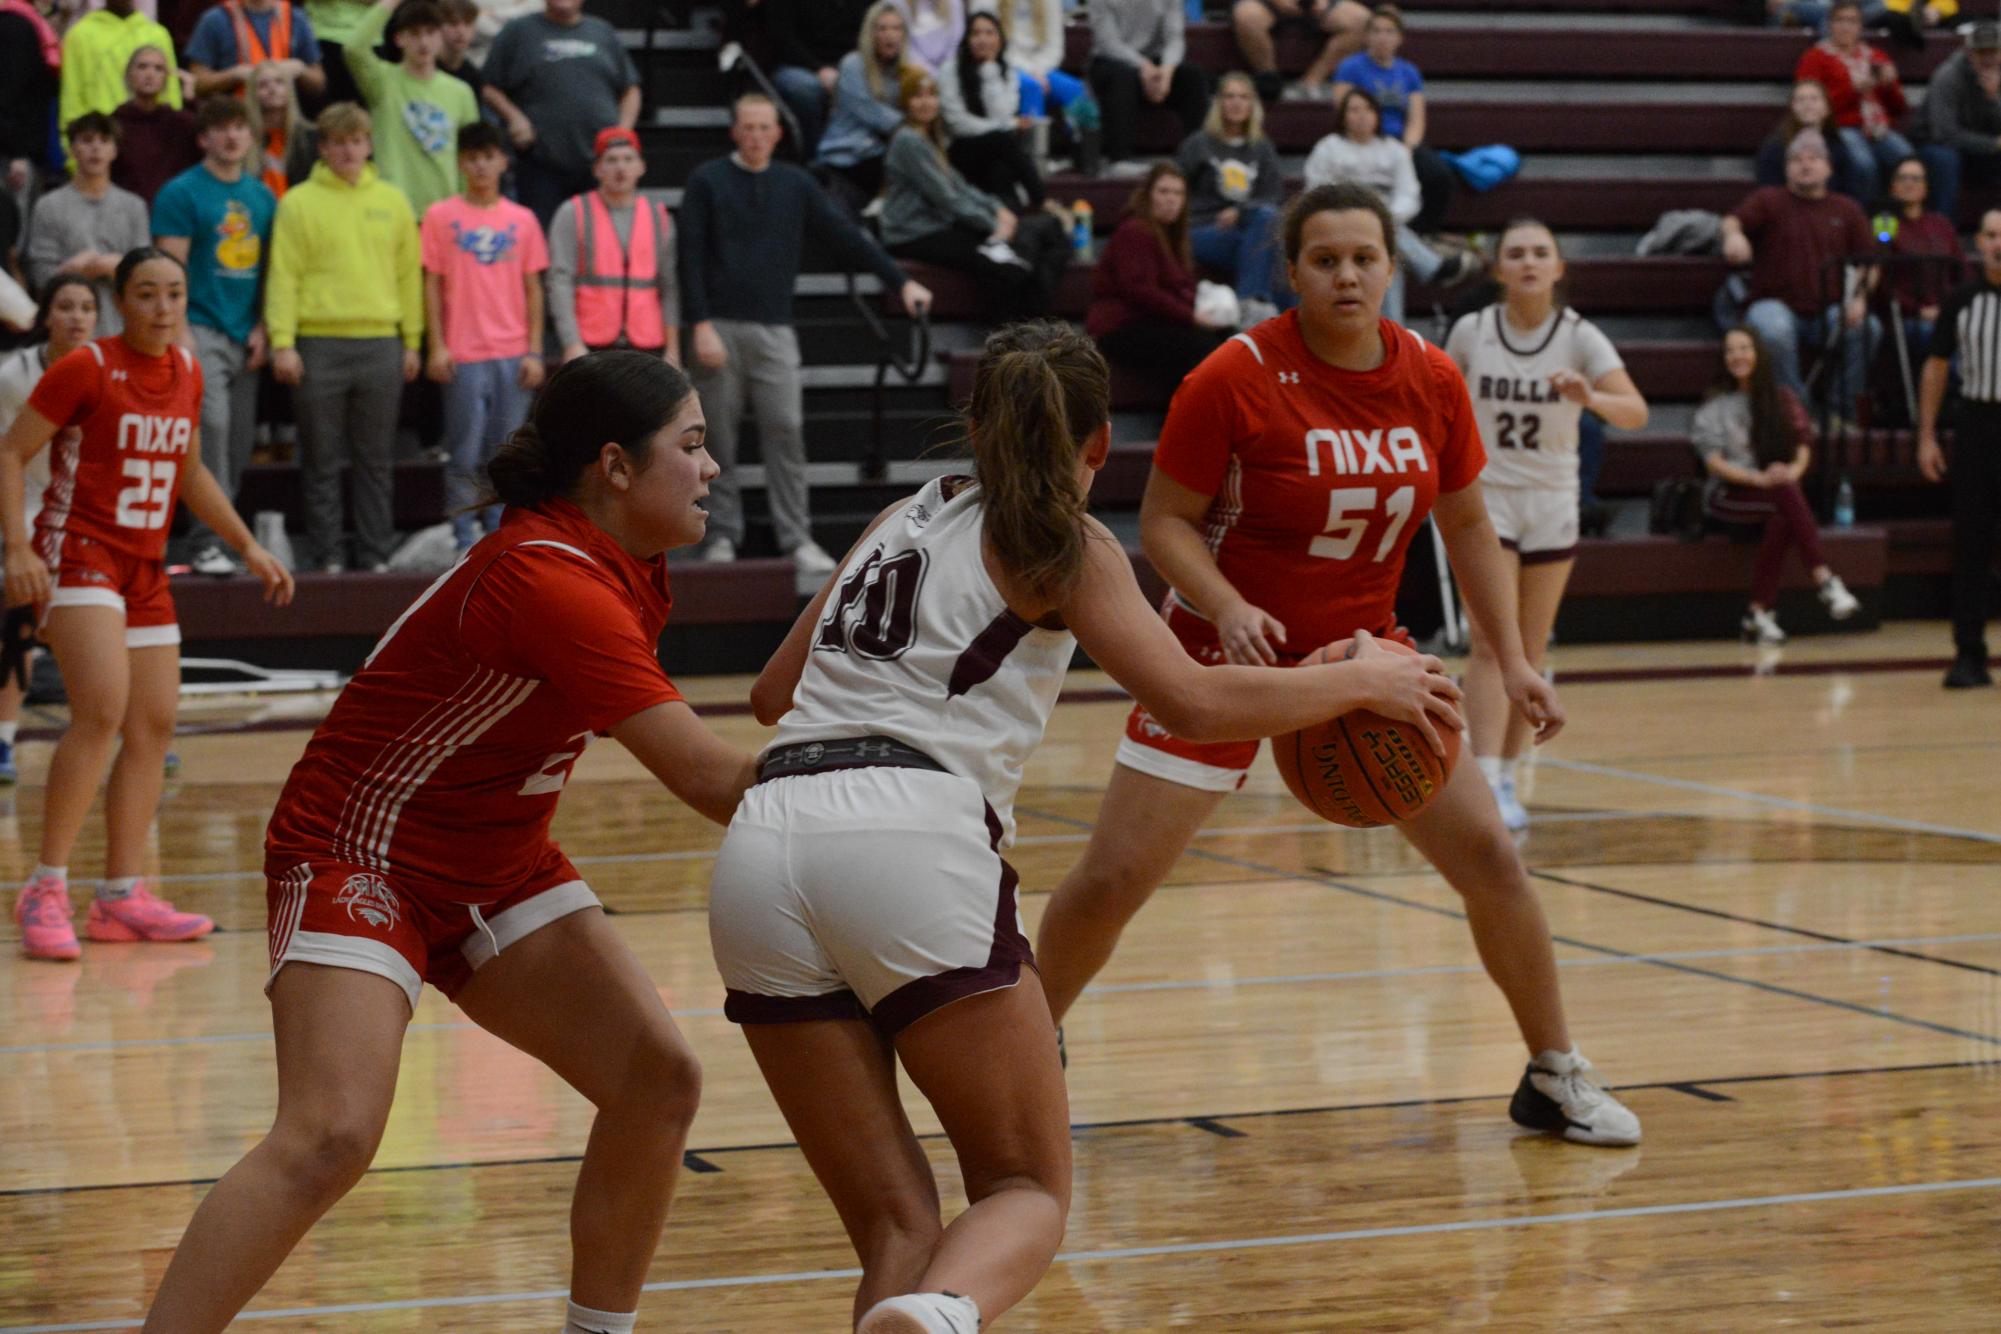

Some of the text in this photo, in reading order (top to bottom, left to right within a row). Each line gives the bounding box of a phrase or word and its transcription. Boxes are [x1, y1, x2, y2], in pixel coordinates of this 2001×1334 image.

[118, 412, 192, 454] NIXA
[1305, 426, 1429, 476] NIXA
[1496, 411, 1540, 450] 22
[116, 458, 176, 530] 23
[1308, 485, 1415, 562] 51
[813, 544, 930, 662] 10
